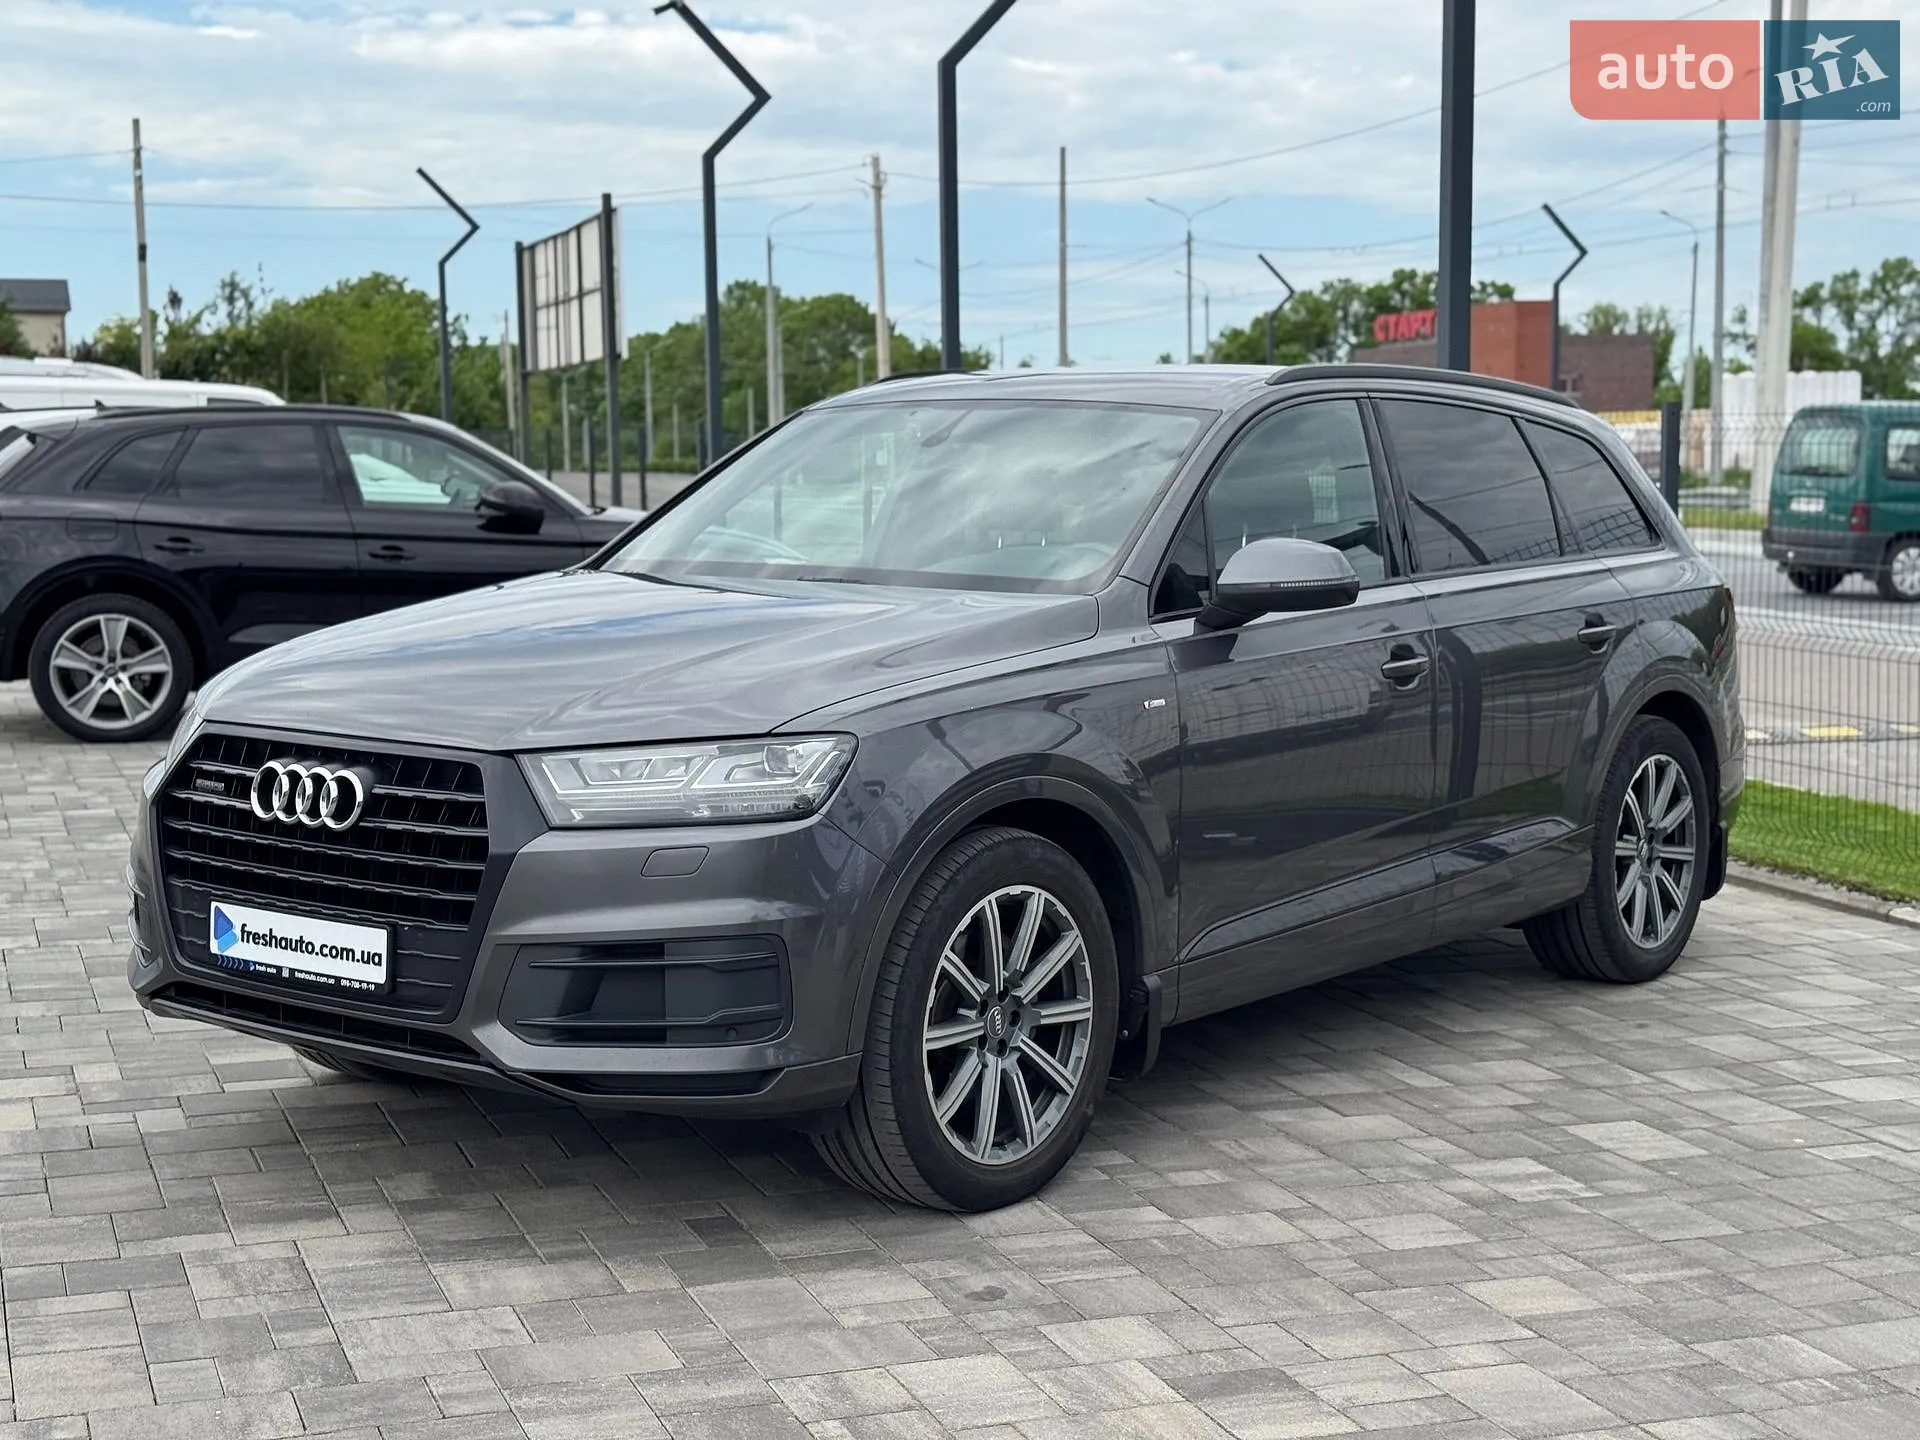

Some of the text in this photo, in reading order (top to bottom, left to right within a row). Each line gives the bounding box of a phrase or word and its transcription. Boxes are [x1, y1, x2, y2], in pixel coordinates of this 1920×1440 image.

[1372, 308, 1437, 342] СТАРТ
[240, 923, 382, 967] freshauto.com.ua
[294, 971, 335, 984] freshauto.com.ua
